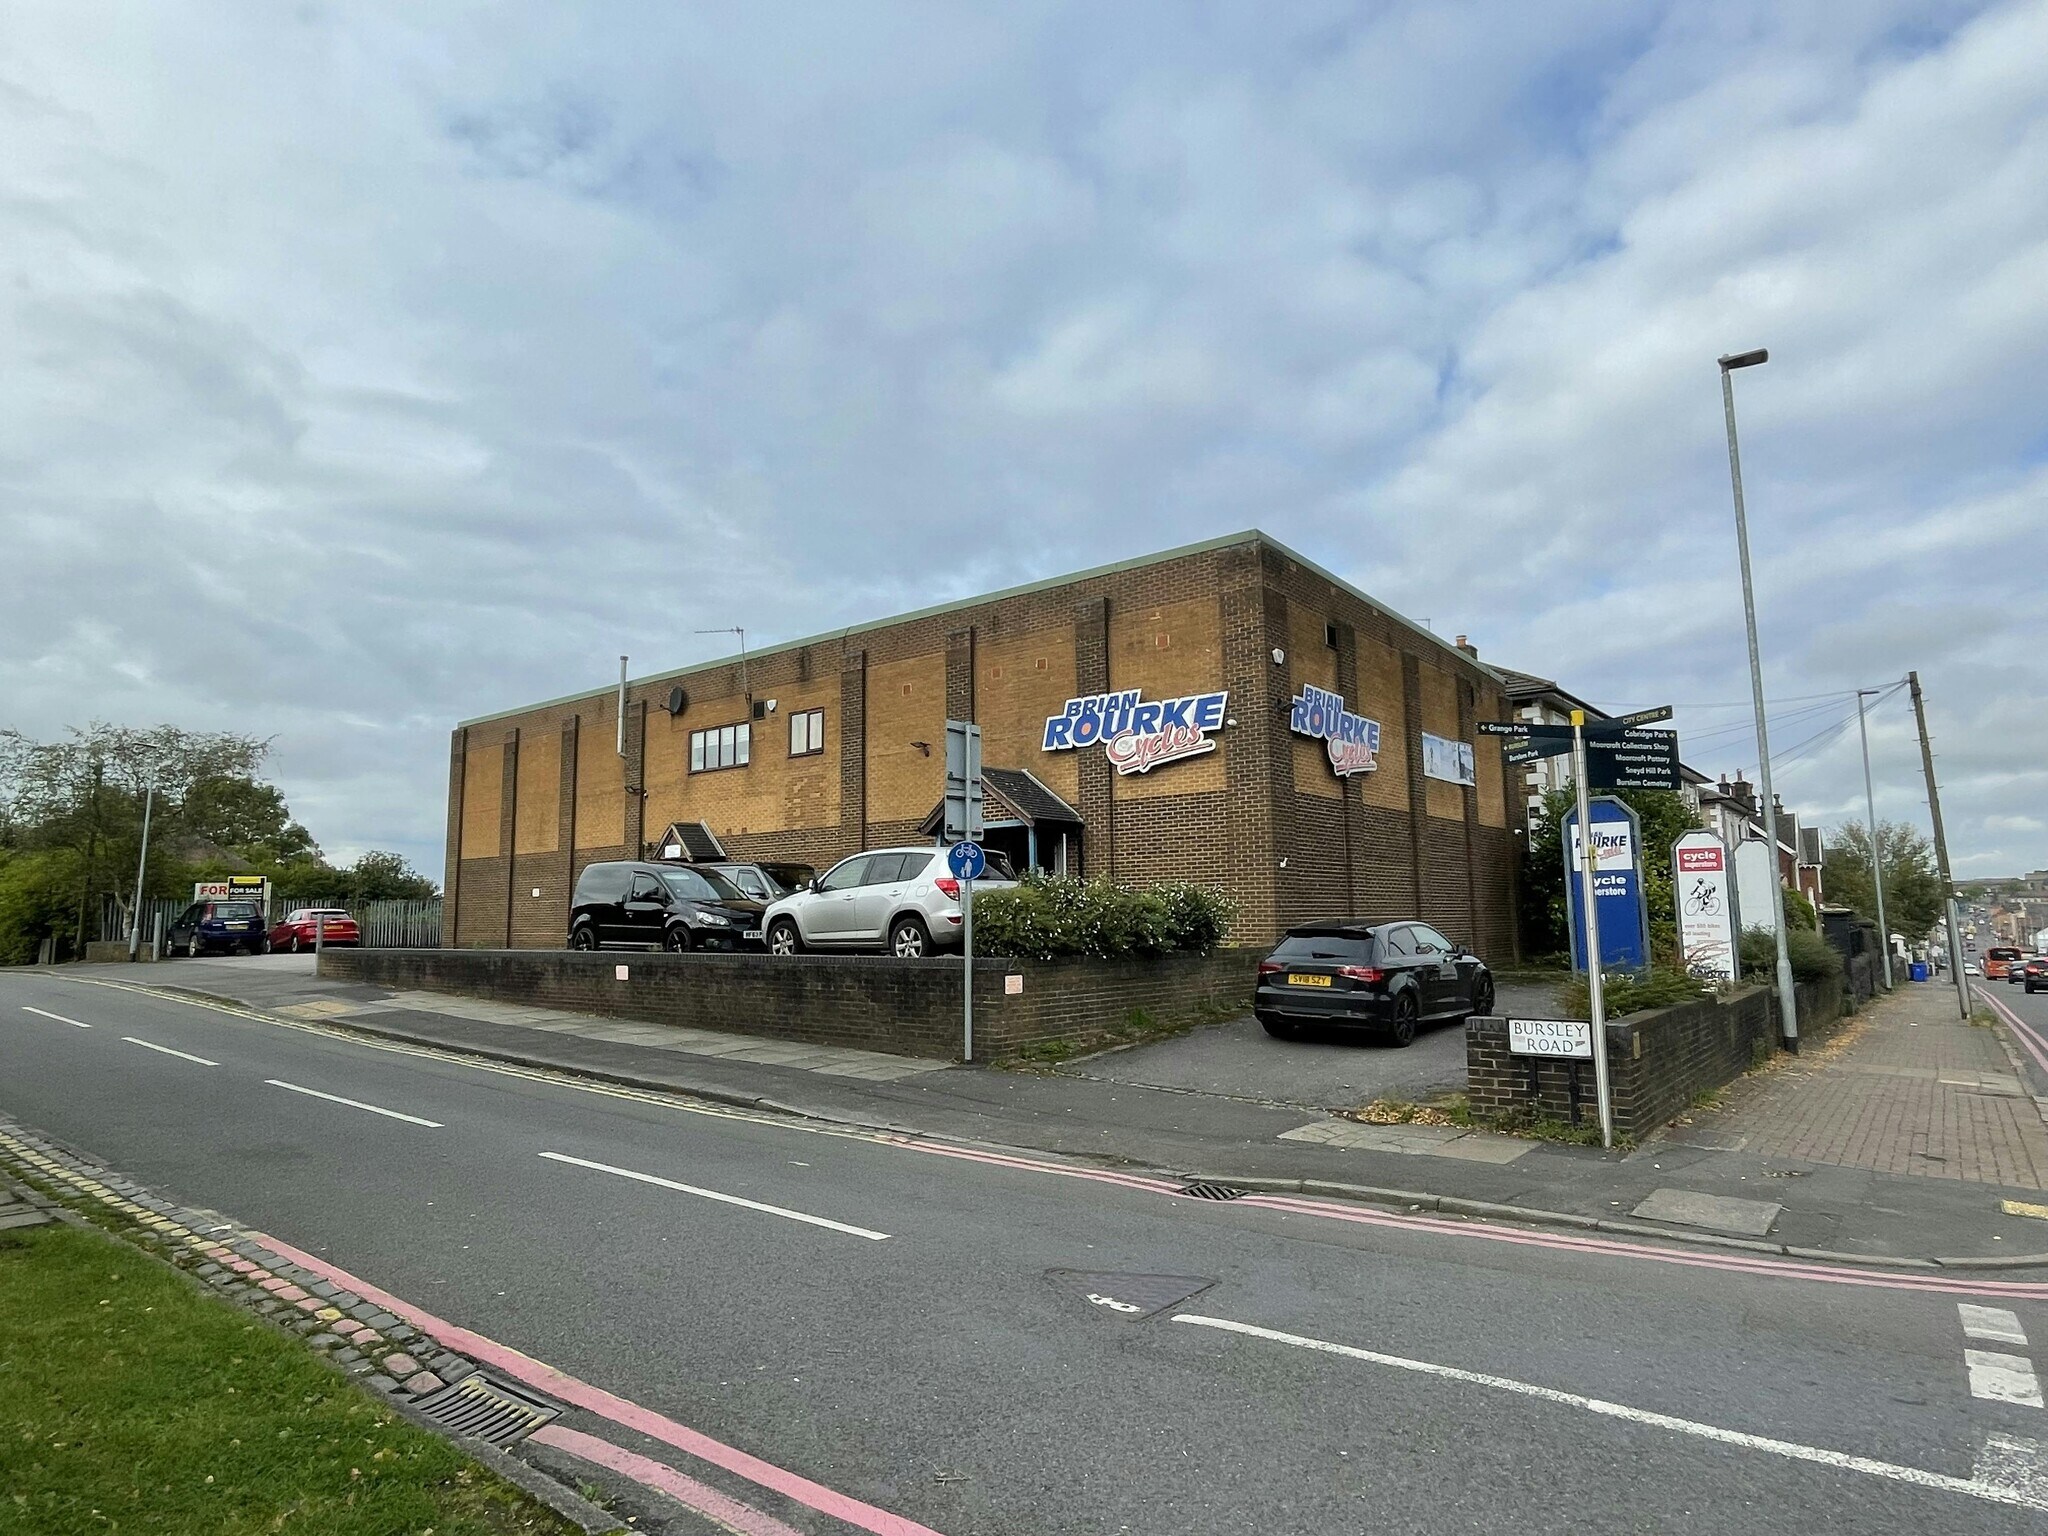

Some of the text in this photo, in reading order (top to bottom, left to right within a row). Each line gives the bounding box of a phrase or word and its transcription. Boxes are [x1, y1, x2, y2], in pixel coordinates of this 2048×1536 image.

[1065, 692, 1137, 718] BRIAN
[1305, 687, 1342, 713] BRIAN
[1044, 695, 1224, 748] ROURKE
[1293, 699, 1379, 750] ROURKE
[1488, 724, 1528, 734] Grange Park
[1624, 730, 1653, 739] Cobridge
[1108, 723, 1200, 766] Cycles
[1621, 741, 1652, 750] Collectors
[1653, 743, 1669, 751] Shop
[1625, 767, 1645, 775] Sneyd
[1642, 780, 1672, 788] Cemetery
[1683, 851, 1717, 862] cycle
[1593, 875, 1627, 887] ycle
[200, 886, 228, 895] FOR
[1514, 1022, 1585, 1037] BURSLEY
[1527, 1038, 1573, 1053] ROAD
